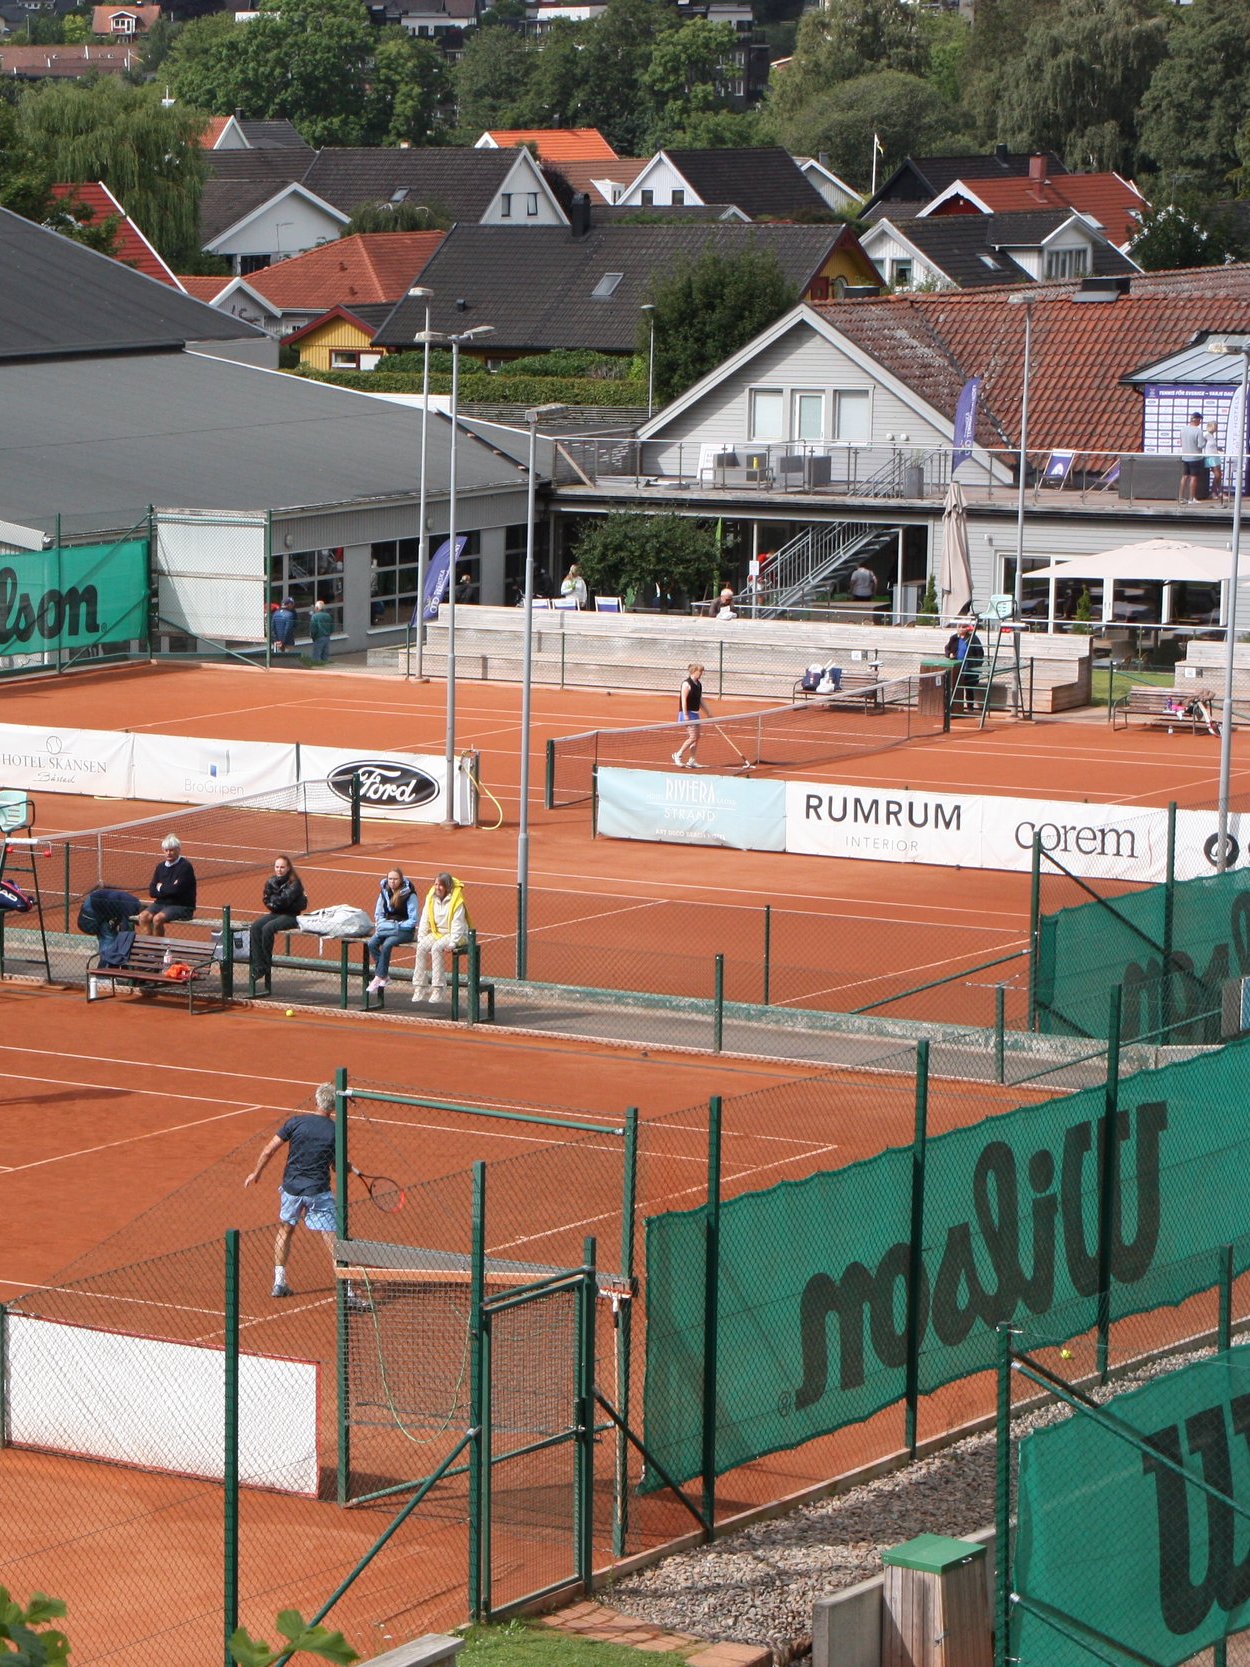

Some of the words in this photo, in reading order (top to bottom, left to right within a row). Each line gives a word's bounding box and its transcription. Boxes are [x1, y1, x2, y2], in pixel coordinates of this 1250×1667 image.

[2, 753, 44, 769] HOTEL
[49, 757, 107, 774] SKANSEN
[350, 765, 417, 802] Ford
[665, 777, 715, 804] RIVIERA
[663, 807, 716, 822] STRAND
[805, 793, 961, 831] RUMRUM
[845, 835, 919, 852] INTERIOR
[1015, 821, 1139, 859] corem
